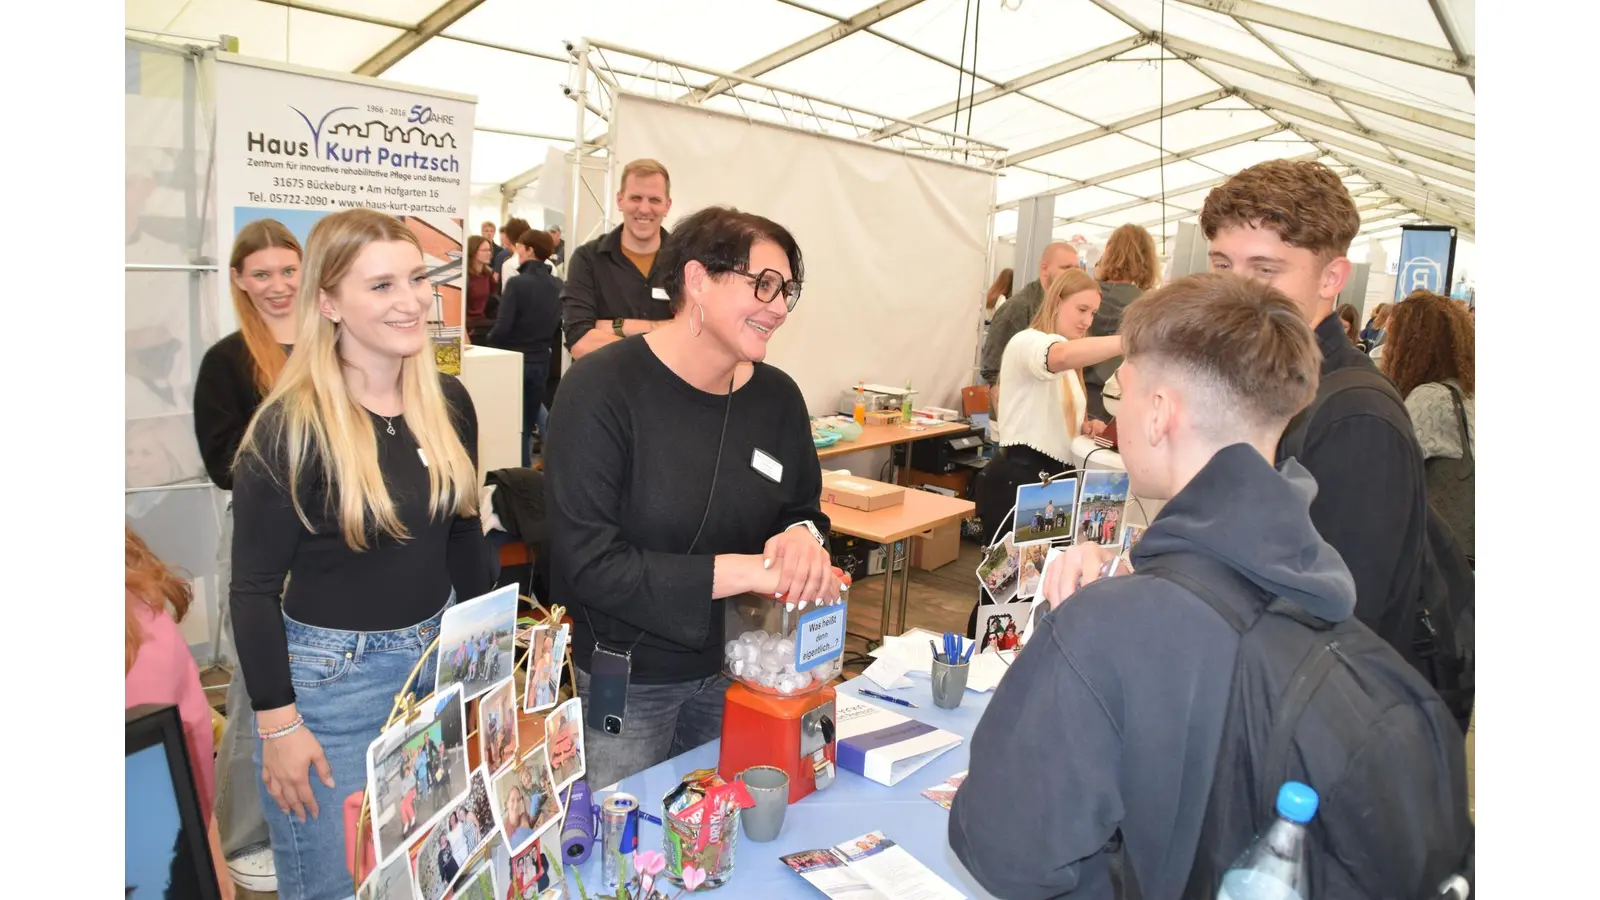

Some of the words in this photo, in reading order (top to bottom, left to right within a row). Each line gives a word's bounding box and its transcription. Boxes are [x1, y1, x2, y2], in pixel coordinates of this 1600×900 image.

[389, 108, 406, 117] 2016
[247, 131, 309, 157] Haus
[326, 141, 372, 164] Kurt
[378, 147, 459, 173] Partzsch
[247, 157, 284, 169] Zentrum
[286, 160, 298, 170] für
[299, 161, 339, 174] innovative
[340, 166, 389, 178] rehabilitative
[389, 170, 412, 182] Pflege
[428, 174, 460, 186] Betreuung
[273, 176, 304, 188] 31675
[306, 179, 357, 195] Bückeburg
[366, 184, 382, 194] Am
[384, 185, 427, 198] Hofgarten
[429, 189, 439, 198] 16
[247, 192, 267, 202] Tel.
[269, 193, 328, 206] 05722-2090
[338, 199, 457, 214] www.haus-kurt-partzsch.de
[808, 622, 821, 633] Was
[822, 615, 837, 628] heißt
[815, 632, 829, 643] denn
